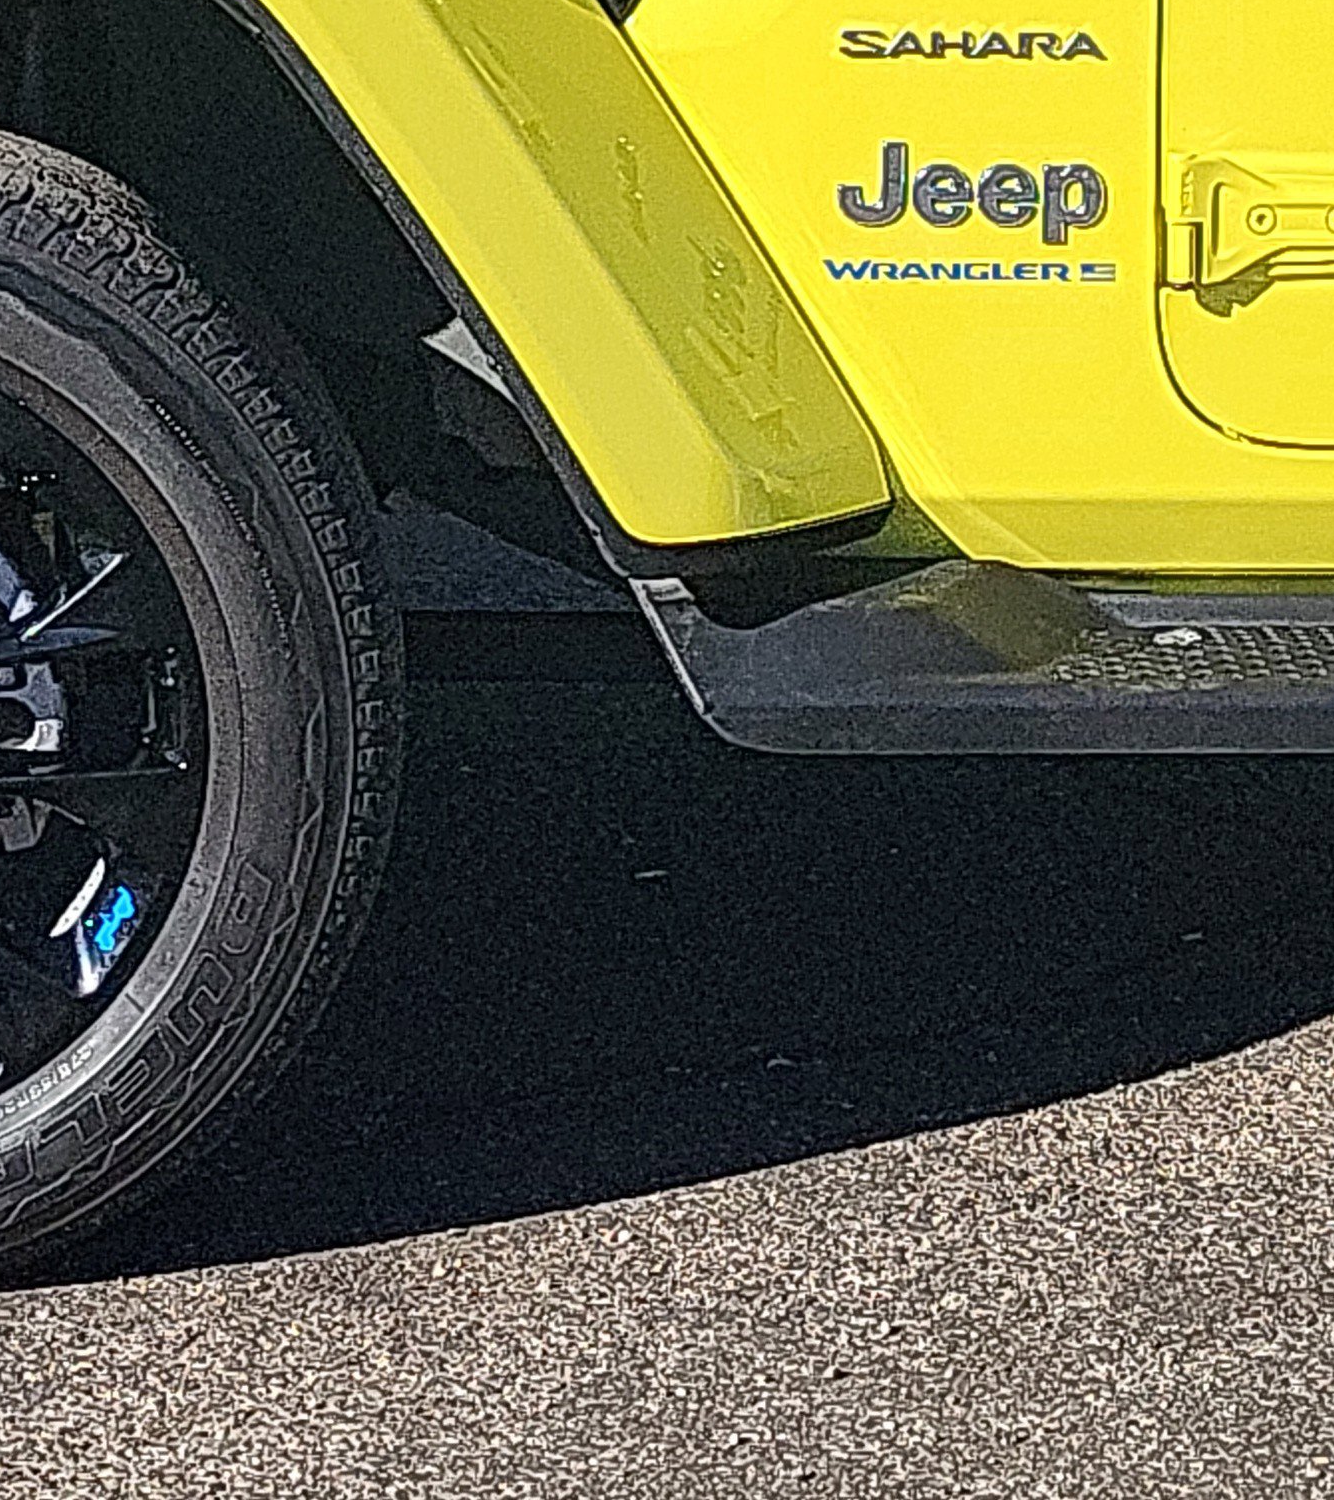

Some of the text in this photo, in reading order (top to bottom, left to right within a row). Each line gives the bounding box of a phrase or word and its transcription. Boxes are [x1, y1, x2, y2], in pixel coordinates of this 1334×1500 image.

[838, 30, 1108, 61] SAHARA
[837, 141, 1108, 246] Jeep
[823, 258, 1072, 282] WRANGLER
